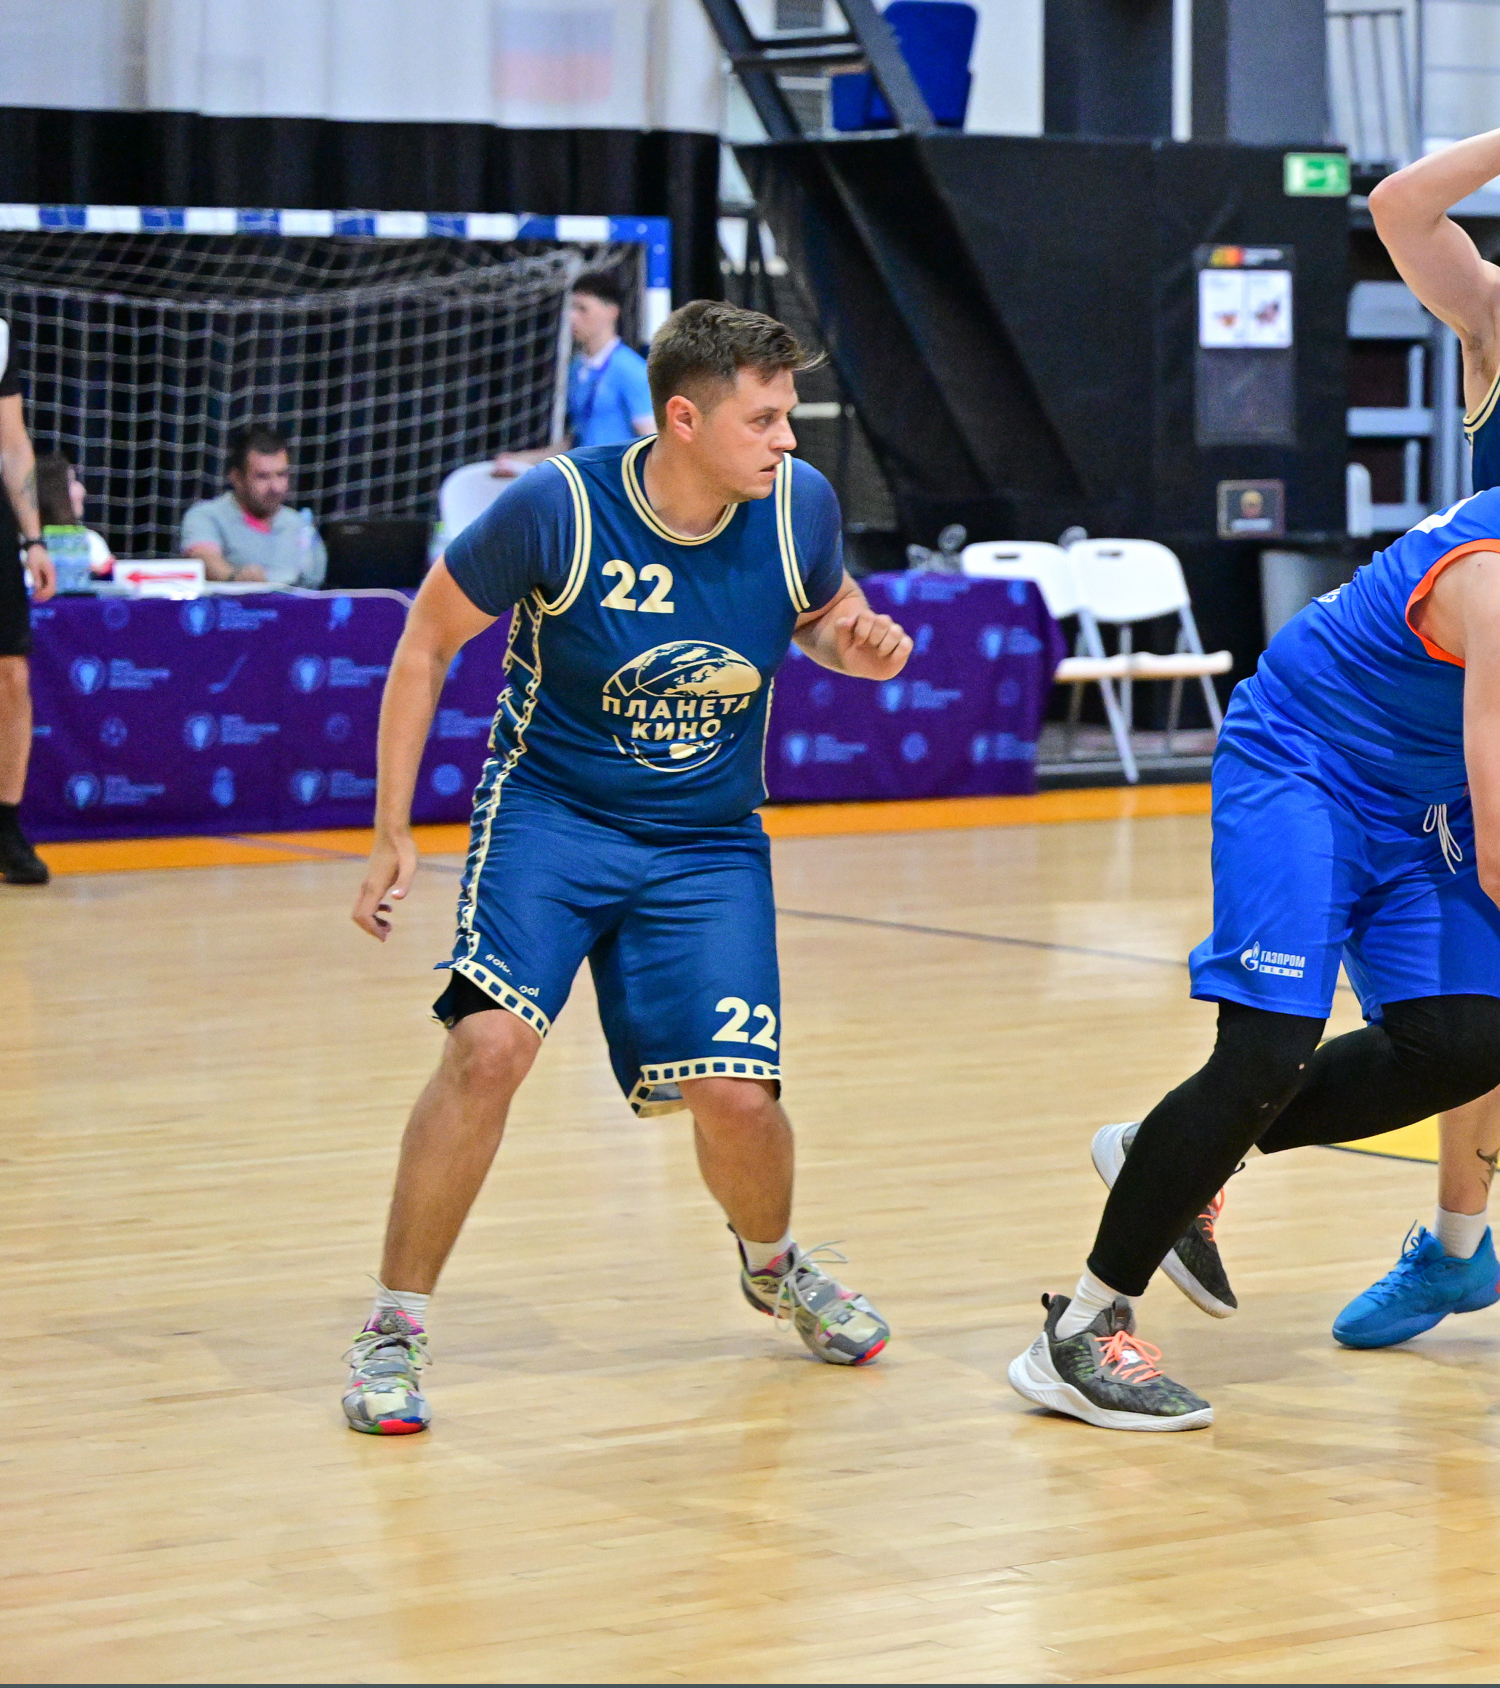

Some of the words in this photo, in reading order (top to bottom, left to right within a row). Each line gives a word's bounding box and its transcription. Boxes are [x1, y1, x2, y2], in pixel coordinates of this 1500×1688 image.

[600, 559, 675, 614] 22
[602, 695, 751, 719] ПЛАНЕТА
[631, 718, 721, 741] КИНО
[1260, 950, 1306, 968] ГАЗПРОМ
[712, 996, 778, 1052] 22
